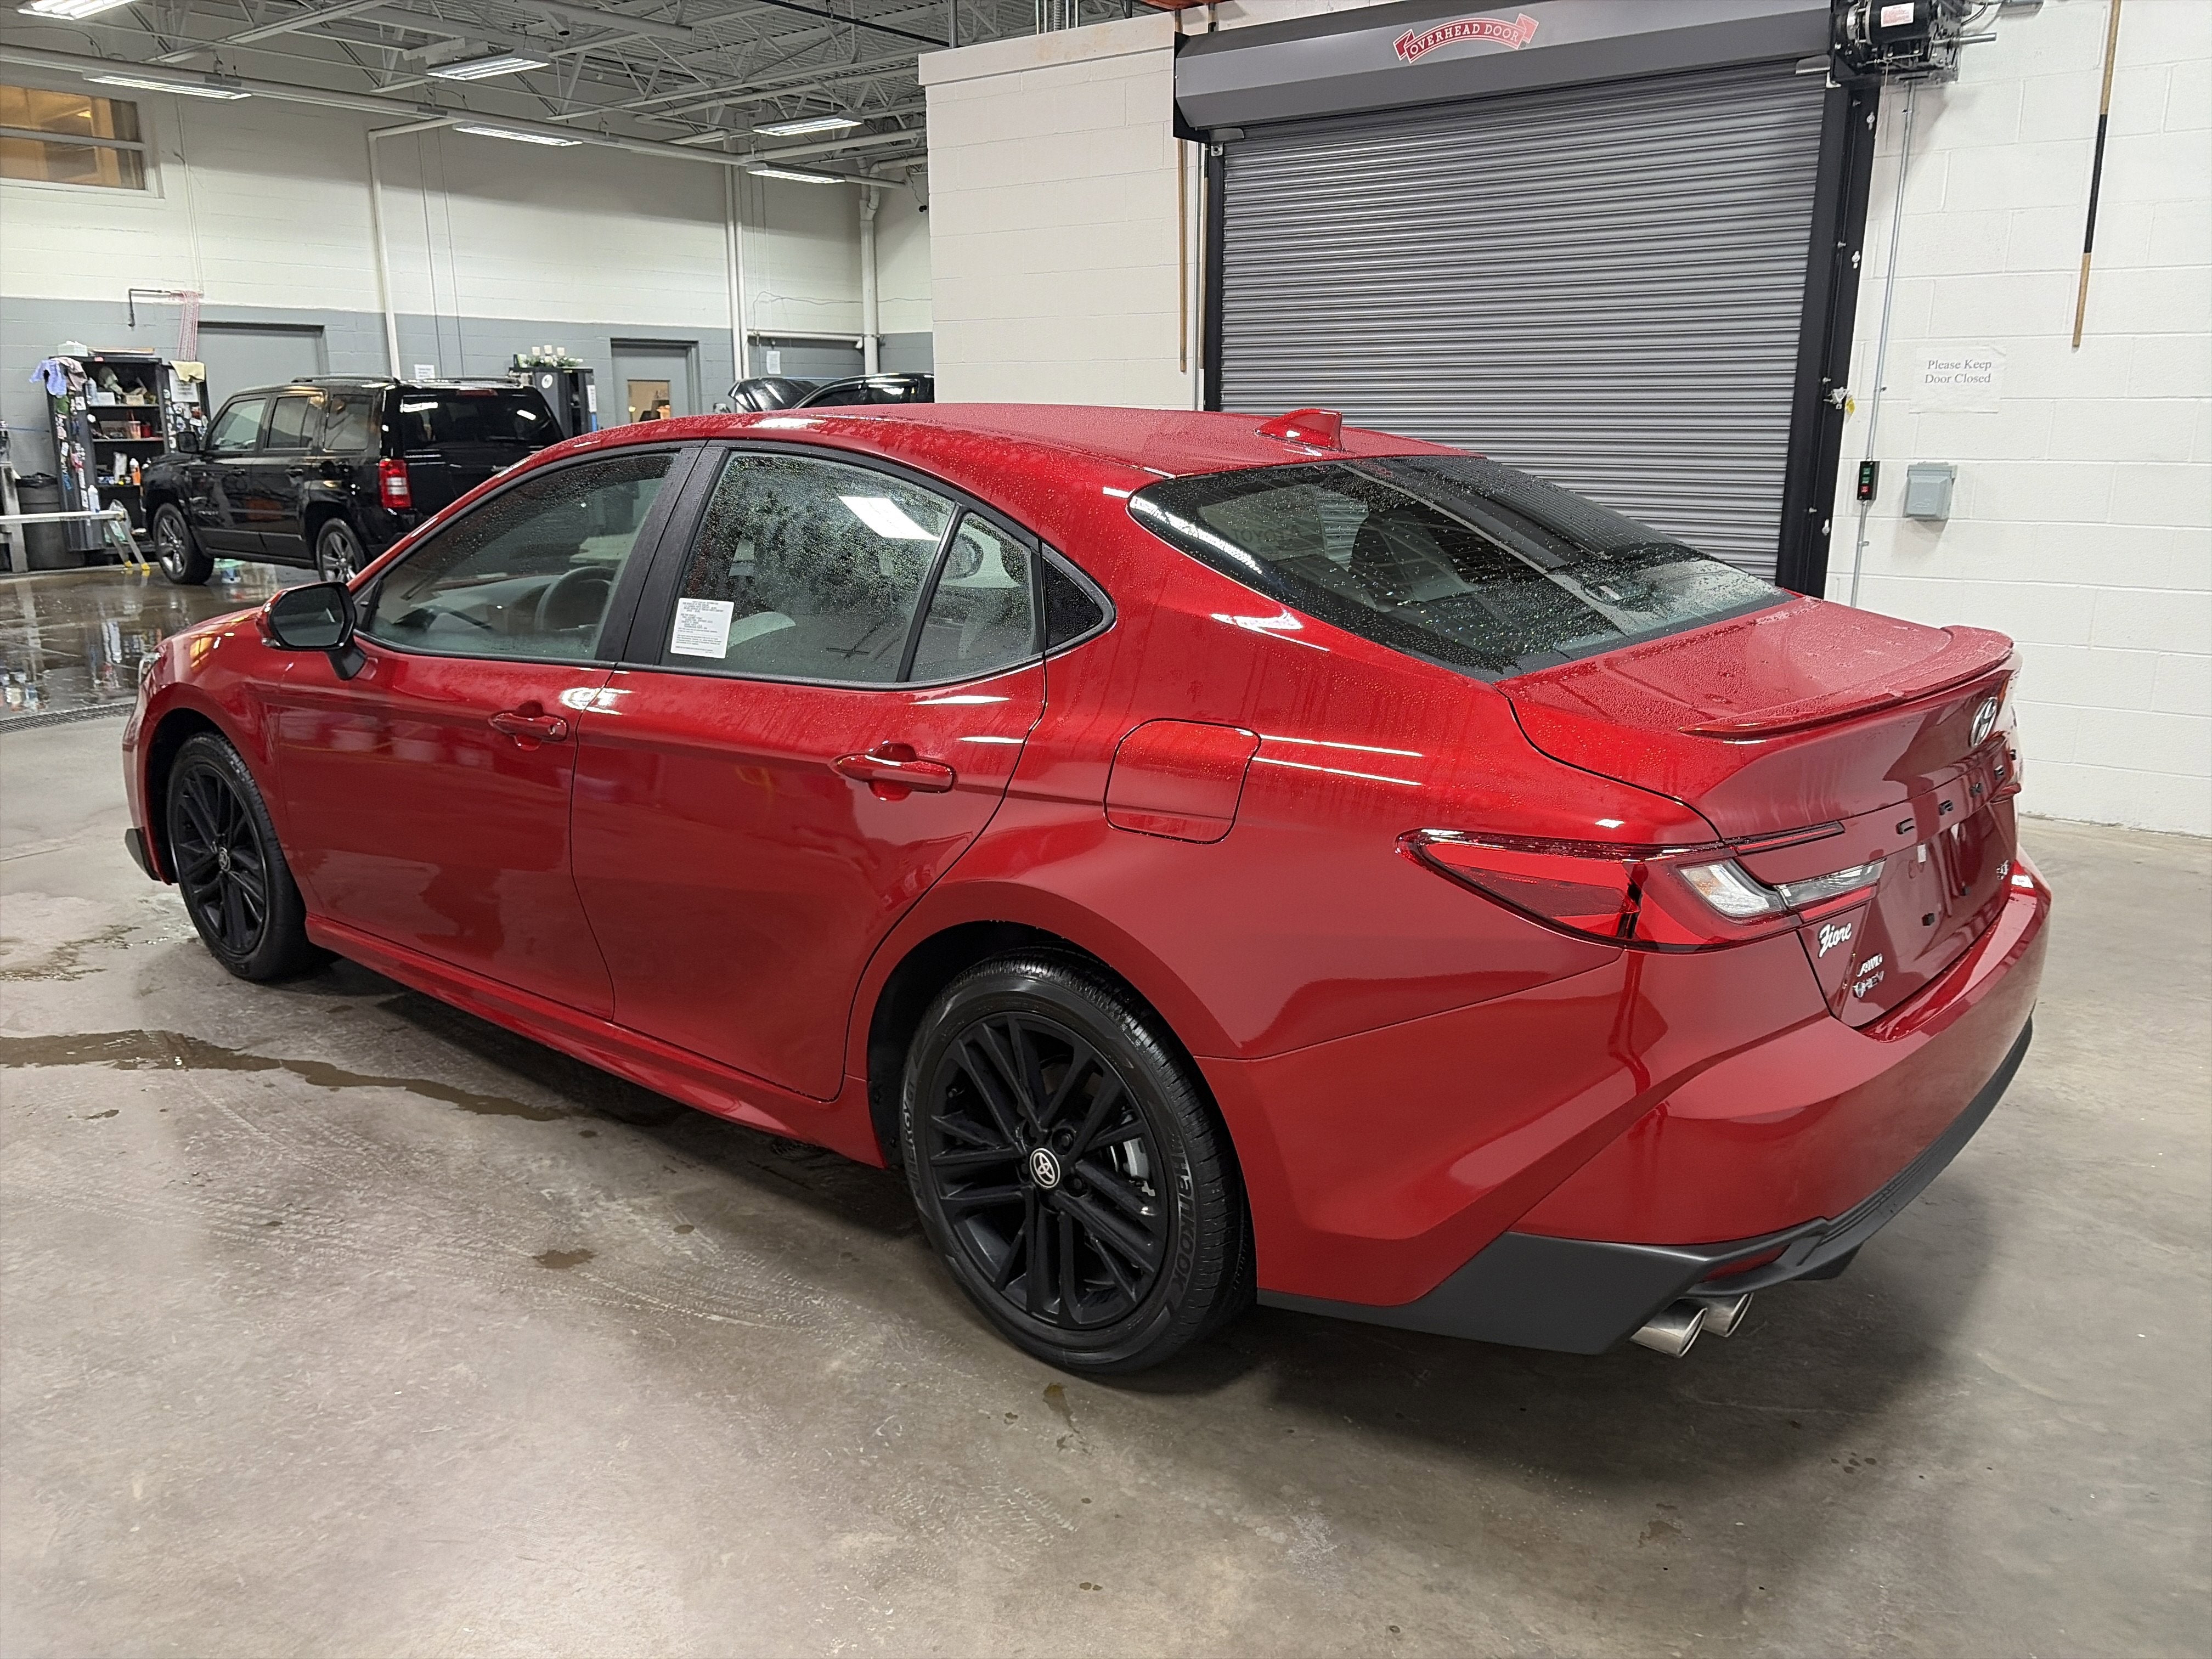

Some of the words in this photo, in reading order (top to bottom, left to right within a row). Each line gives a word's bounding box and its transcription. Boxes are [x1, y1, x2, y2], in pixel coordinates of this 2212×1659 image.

[1409, 24, 1481, 55] OVERHEAD
[1483, 24, 1519, 42] DOOR
[1925, 374, 1952, 383] Door
[1954, 373, 1991, 383] Closed
[1927, 359, 1961, 370] Please
[1964, 359, 1992, 371] Keep
[1818, 922, 1853, 958] Fiore
[1857, 953, 1884, 977] AWD
[903, 1100, 921, 1187] INERGY
